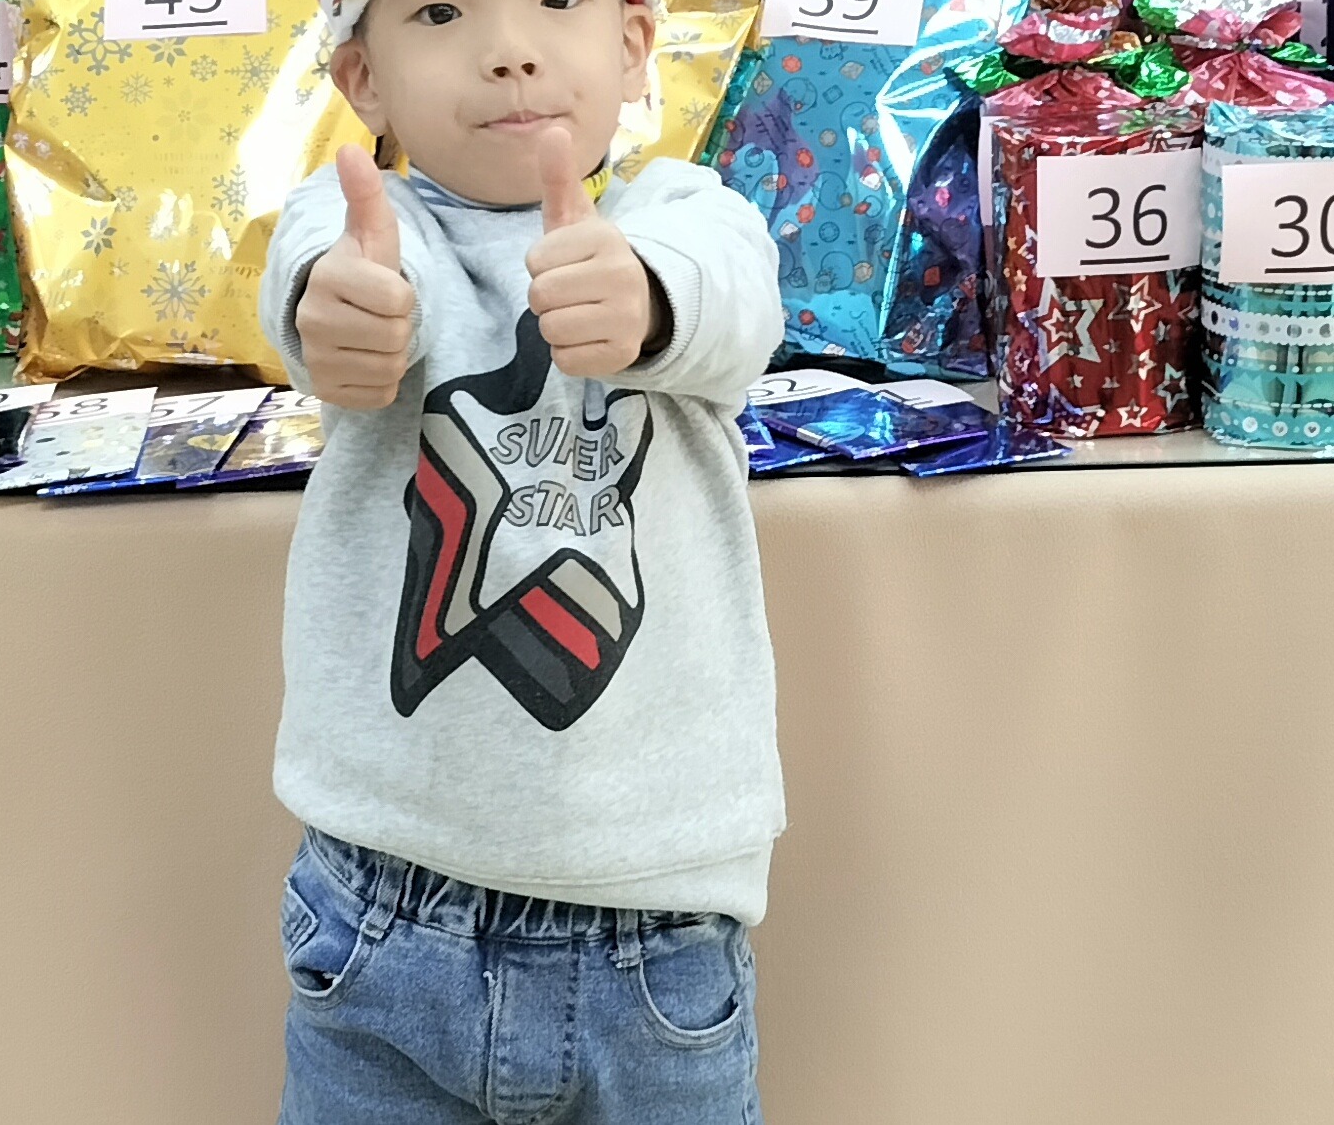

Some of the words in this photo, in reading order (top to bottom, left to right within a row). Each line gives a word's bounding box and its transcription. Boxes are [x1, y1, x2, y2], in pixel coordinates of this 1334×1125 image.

[1084, 184, 1170, 252] 36
[151, 394, 226, 420] 57
[503, 479, 625, 537] STAR
